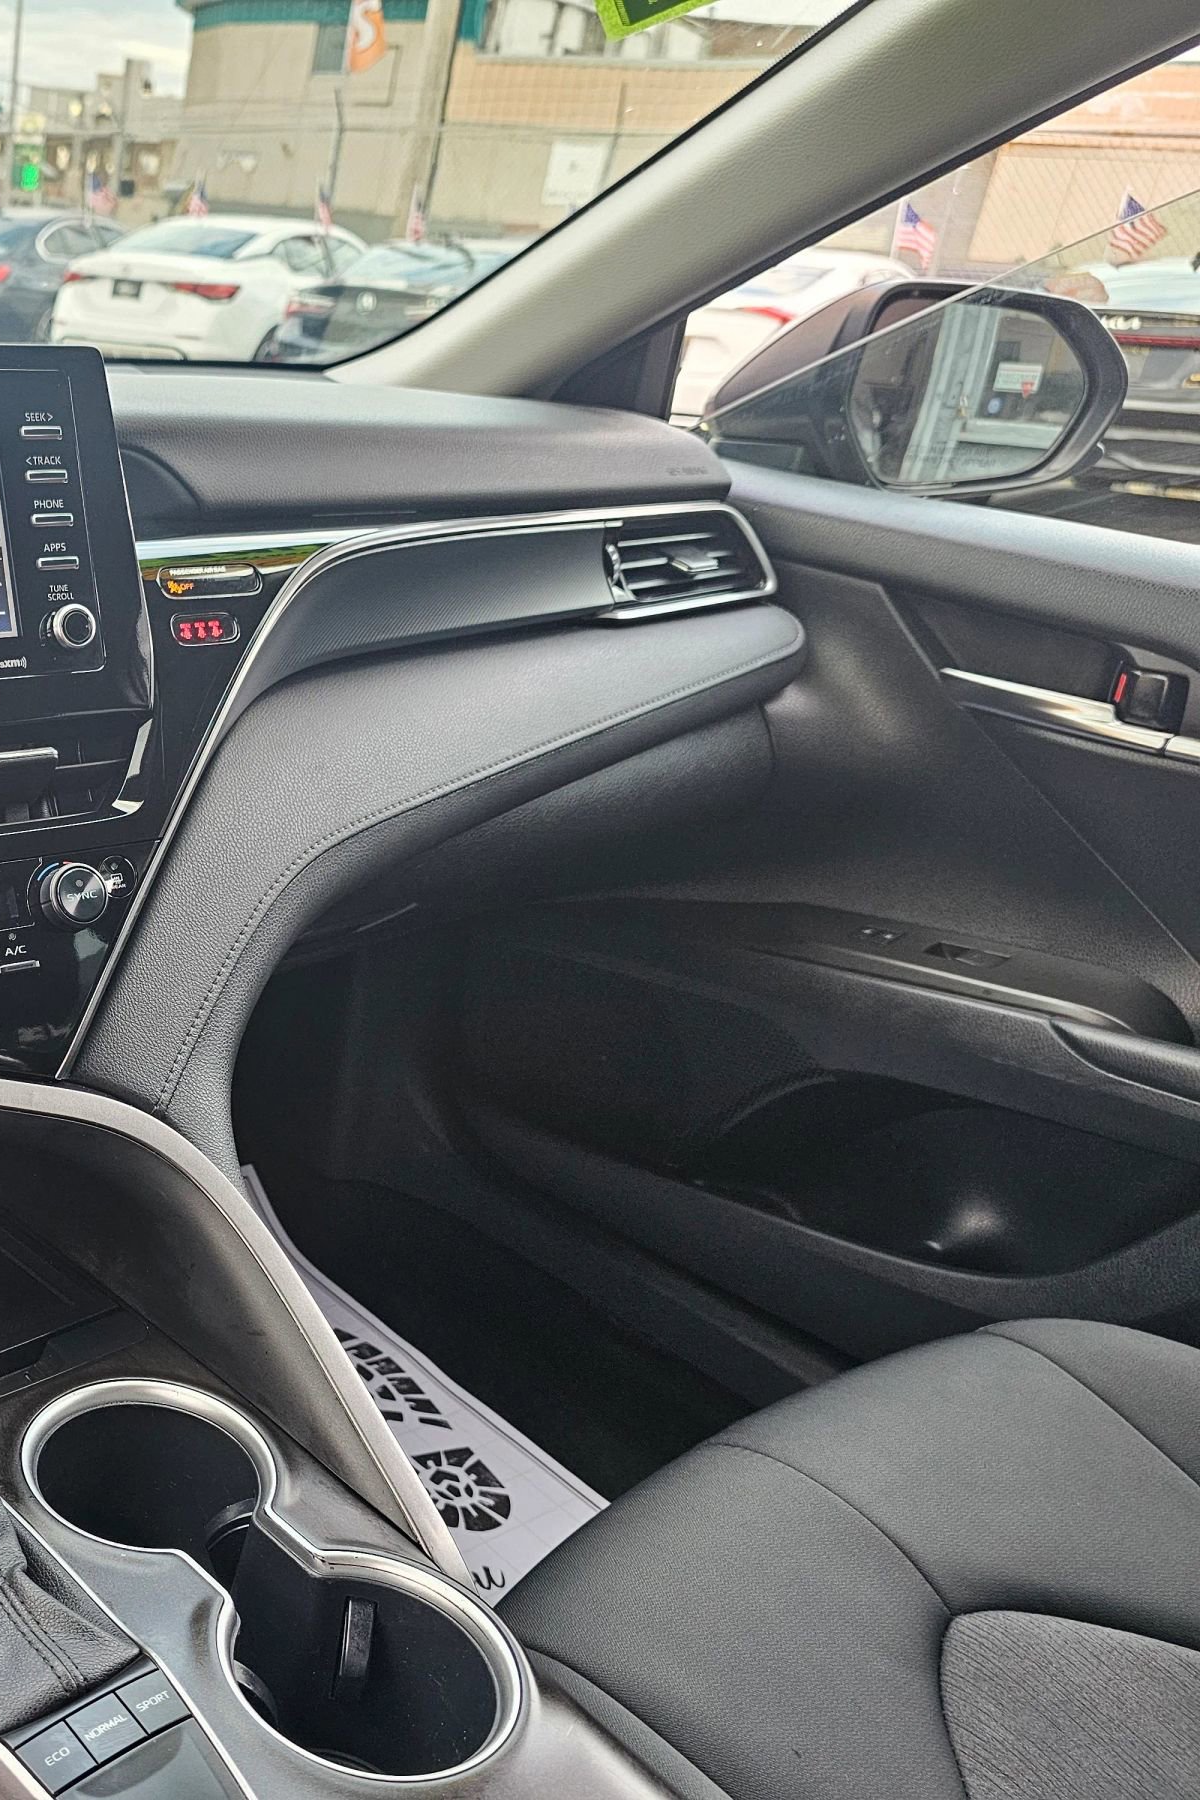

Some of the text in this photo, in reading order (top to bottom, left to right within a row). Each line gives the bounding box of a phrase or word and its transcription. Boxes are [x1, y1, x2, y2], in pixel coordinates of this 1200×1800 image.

[33, 499, 64, 509] PHONE
[43, 543, 66, 552] APPS
[49, 584, 69, 593] TUNE
[47, 592, 75, 601] SCROLL
[66, 889, 98, 902] SYNC
[5, 945, 27, 956] A/C
[135, 1690, 171, 1713] SPORT
[84, 1714, 128, 1742] NORMAL
[44, 1746, 71, 1767] ECO
